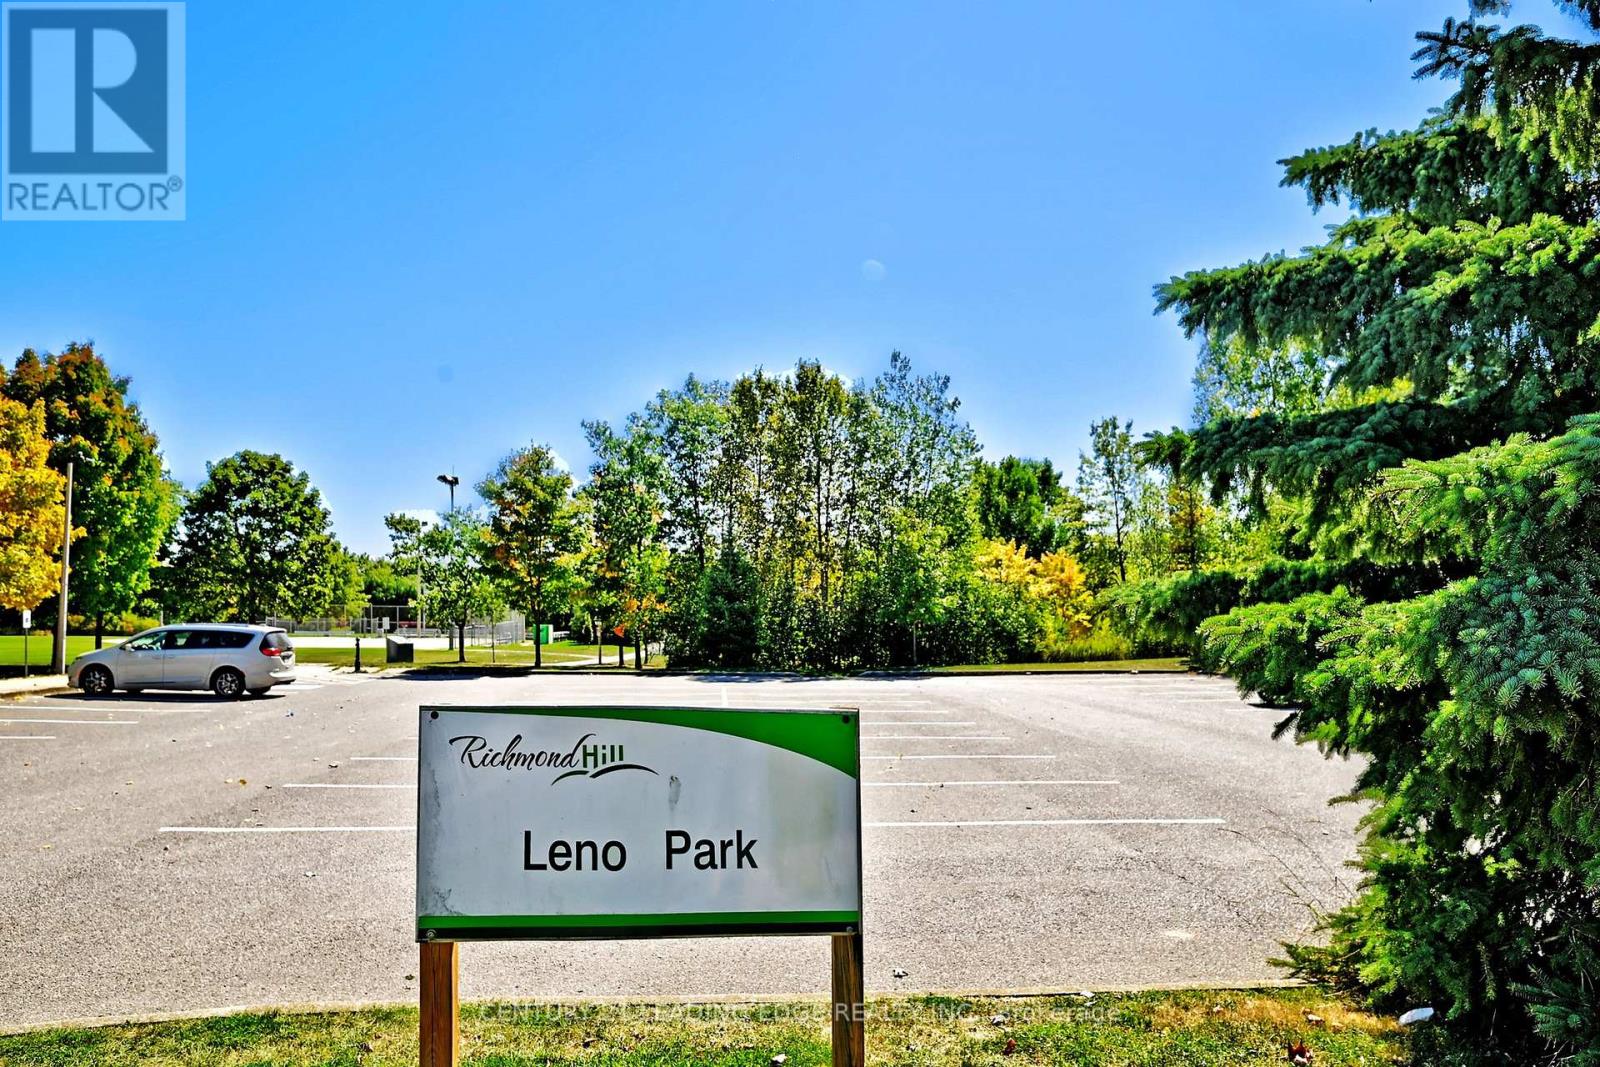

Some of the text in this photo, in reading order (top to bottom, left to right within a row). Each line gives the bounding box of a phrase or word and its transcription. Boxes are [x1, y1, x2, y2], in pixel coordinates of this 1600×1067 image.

[449, 733, 624, 771] Richmond Hill
[523, 830, 758, 871] Leno Park
